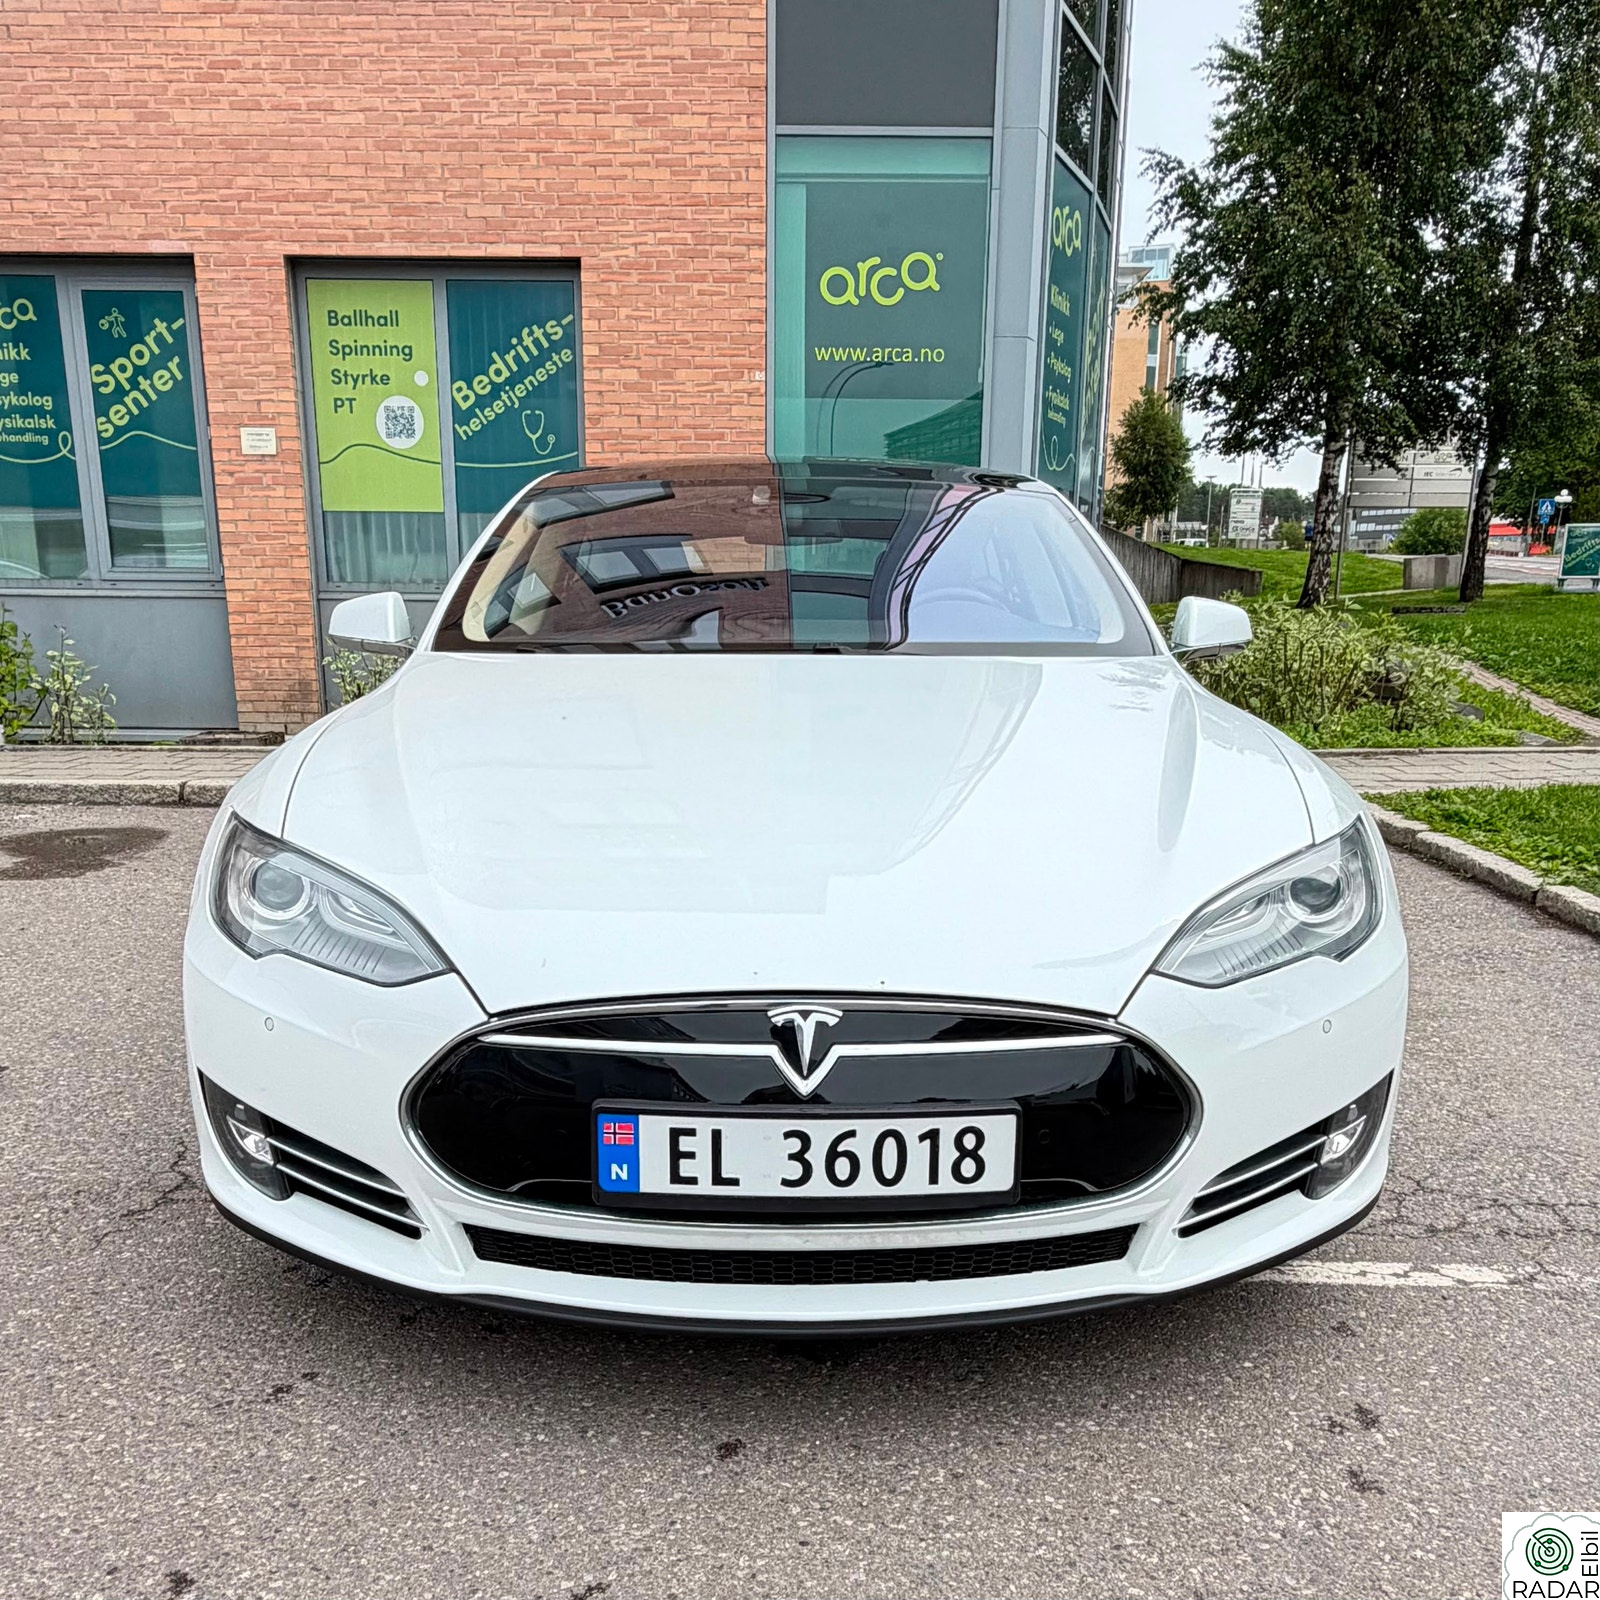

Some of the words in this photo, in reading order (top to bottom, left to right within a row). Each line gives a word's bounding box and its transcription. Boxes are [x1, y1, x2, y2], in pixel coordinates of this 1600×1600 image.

[1053, 205, 1082, 257] arca
[819, 251, 941, 306] arca
[0, 298, 38, 330] ca
[327, 309, 400, 328] Ballhall
[90, 317, 185, 394] Sport-
[328, 339, 413, 362] Spinning
[451, 313, 574, 411] Bedrifts-
[814, 346, 945, 363] www.arca.no
[97, 355, 184, 438] senter
[331, 368, 391, 390] Styrke
[454, 347, 574, 441] helsetjeneste
[333, 397, 357, 414] PT
[610, 1163, 629, 1181] N
[668, 1126, 741, 1188] EL
[779, 1125, 986, 1189] 36018
